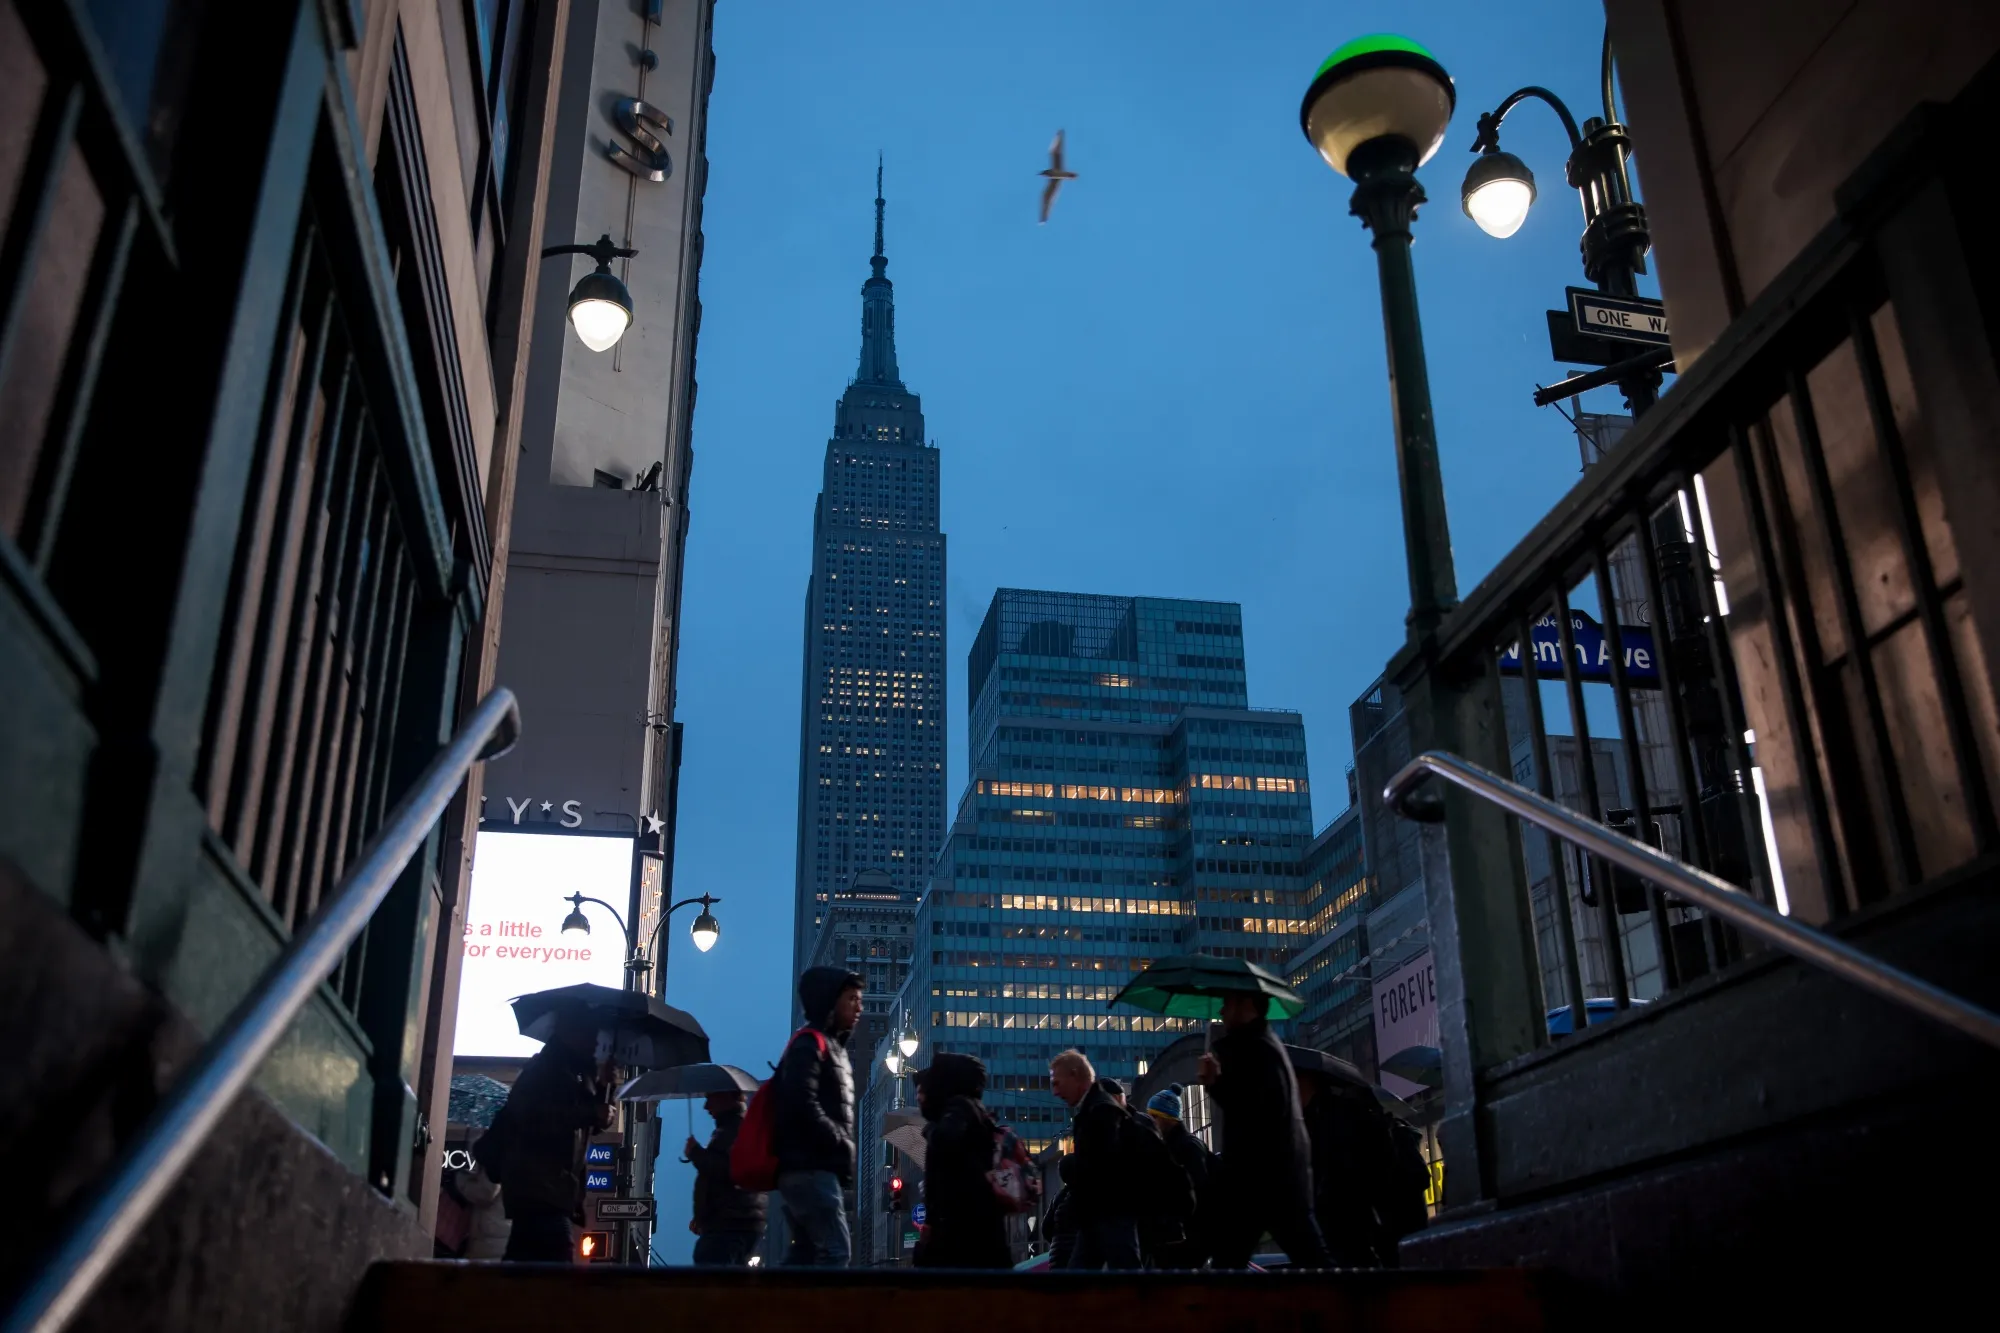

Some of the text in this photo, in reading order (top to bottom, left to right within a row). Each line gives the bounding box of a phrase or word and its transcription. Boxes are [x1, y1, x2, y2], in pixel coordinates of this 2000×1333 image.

[1596, 309, 1632, 327] ONE
[1648, 316, 1670, 333] W
[1597, 639, 1651, 669] Ave
[480, 924, 492, 936] a
[499, 920, 542, 938] little
[496, 945, 592, 963] everyone
[1381, 965, 1436, 1029] FOREVE
[590, 1148, 611, 1160] Ave
[586, 1175, 608, 1186] Ave
